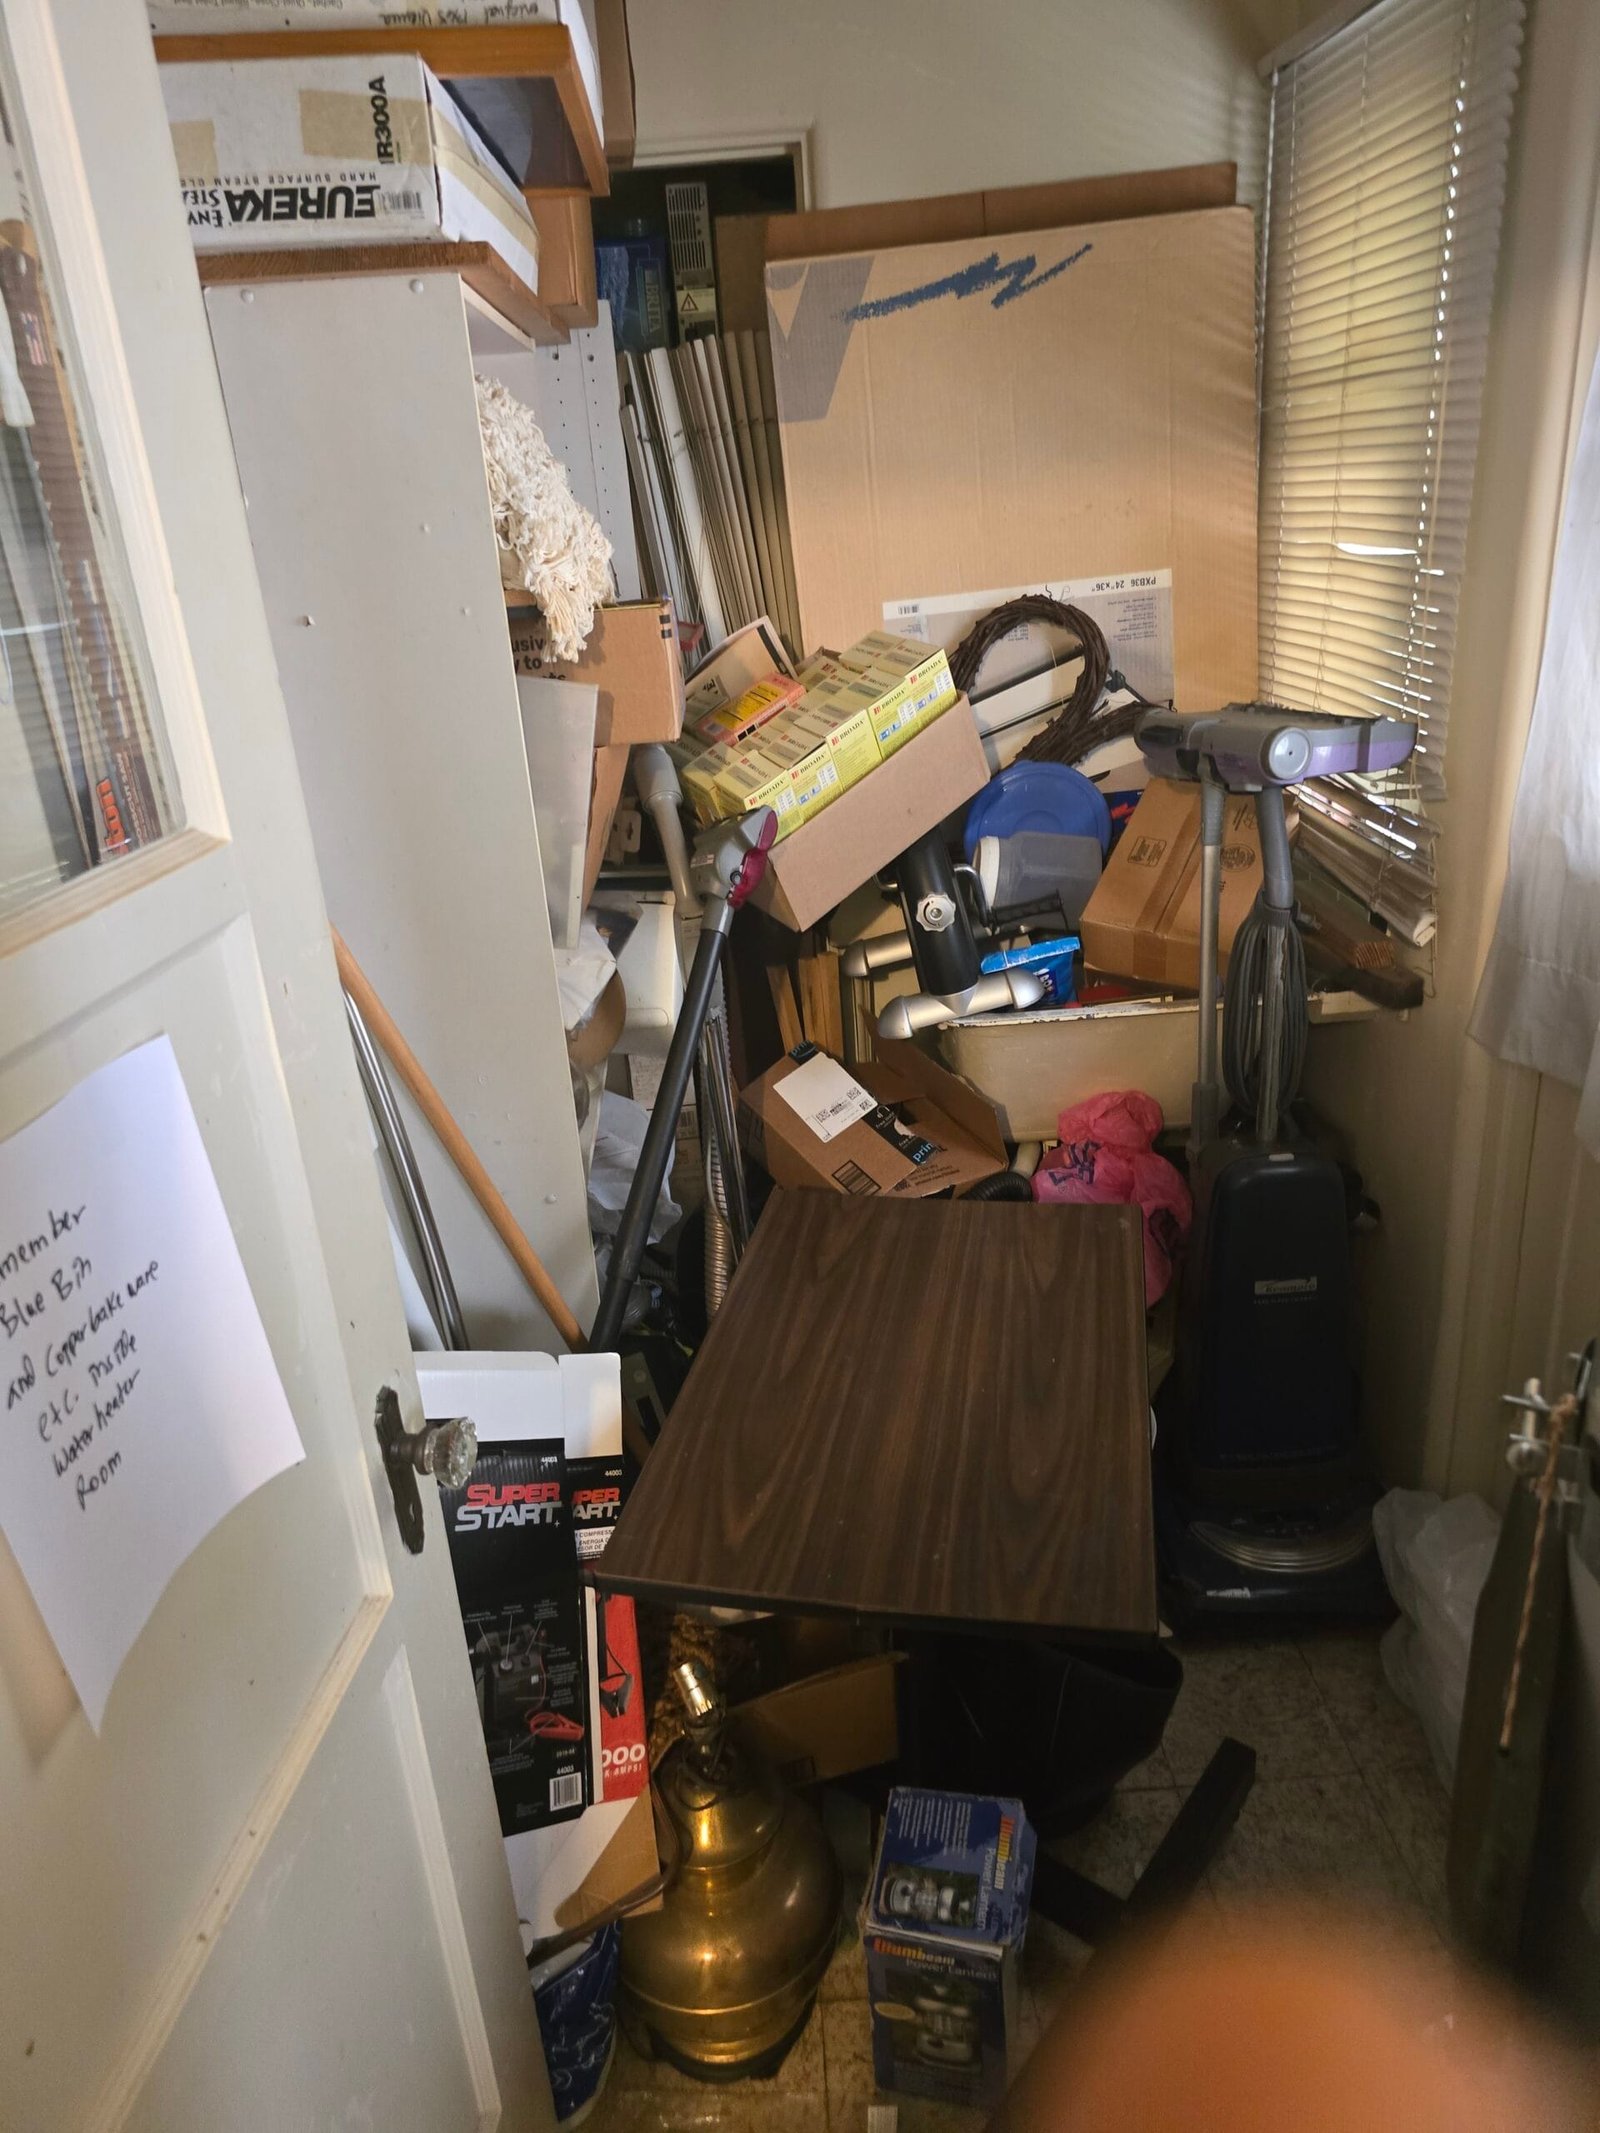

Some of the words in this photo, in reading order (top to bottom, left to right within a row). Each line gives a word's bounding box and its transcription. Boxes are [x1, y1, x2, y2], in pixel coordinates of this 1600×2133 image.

[369, 75, 395, 165] IR300A
[214, 176, 260, 185] STEAM
[268, 174, 331, 184] SURFACE
[340, 172, 376, 182] HARD
[223, 185, 381, 223] EUREKA
[187, 210, 224, 228] ENV
[645, 285, 662, 334] BRITA
[1130, 576, 1156, 587] PXB36
[917, 659, 942, 679] BROADA
[881, 690, 905, 710] BROADA
[839, 719, 865, 741] BROADA
[799, 753, 827, 774] BROADA
[757, 779, 786, 800] BROADA
[0, 1292, 45, 1339] Blue
[51, 1255, 92, 1301] Bin
[541, 1456, 558, 1464] 44003
[75, 1450, 122, 1512] Room
[465, 1482, 561, 1508] SUPER
[455, 1501, 563, 1532] START
[556, 1764, 575, 1776] 44003
[981, 1846, 997, 1884] Power
[976, 1885, 993, 1932] Lantern
